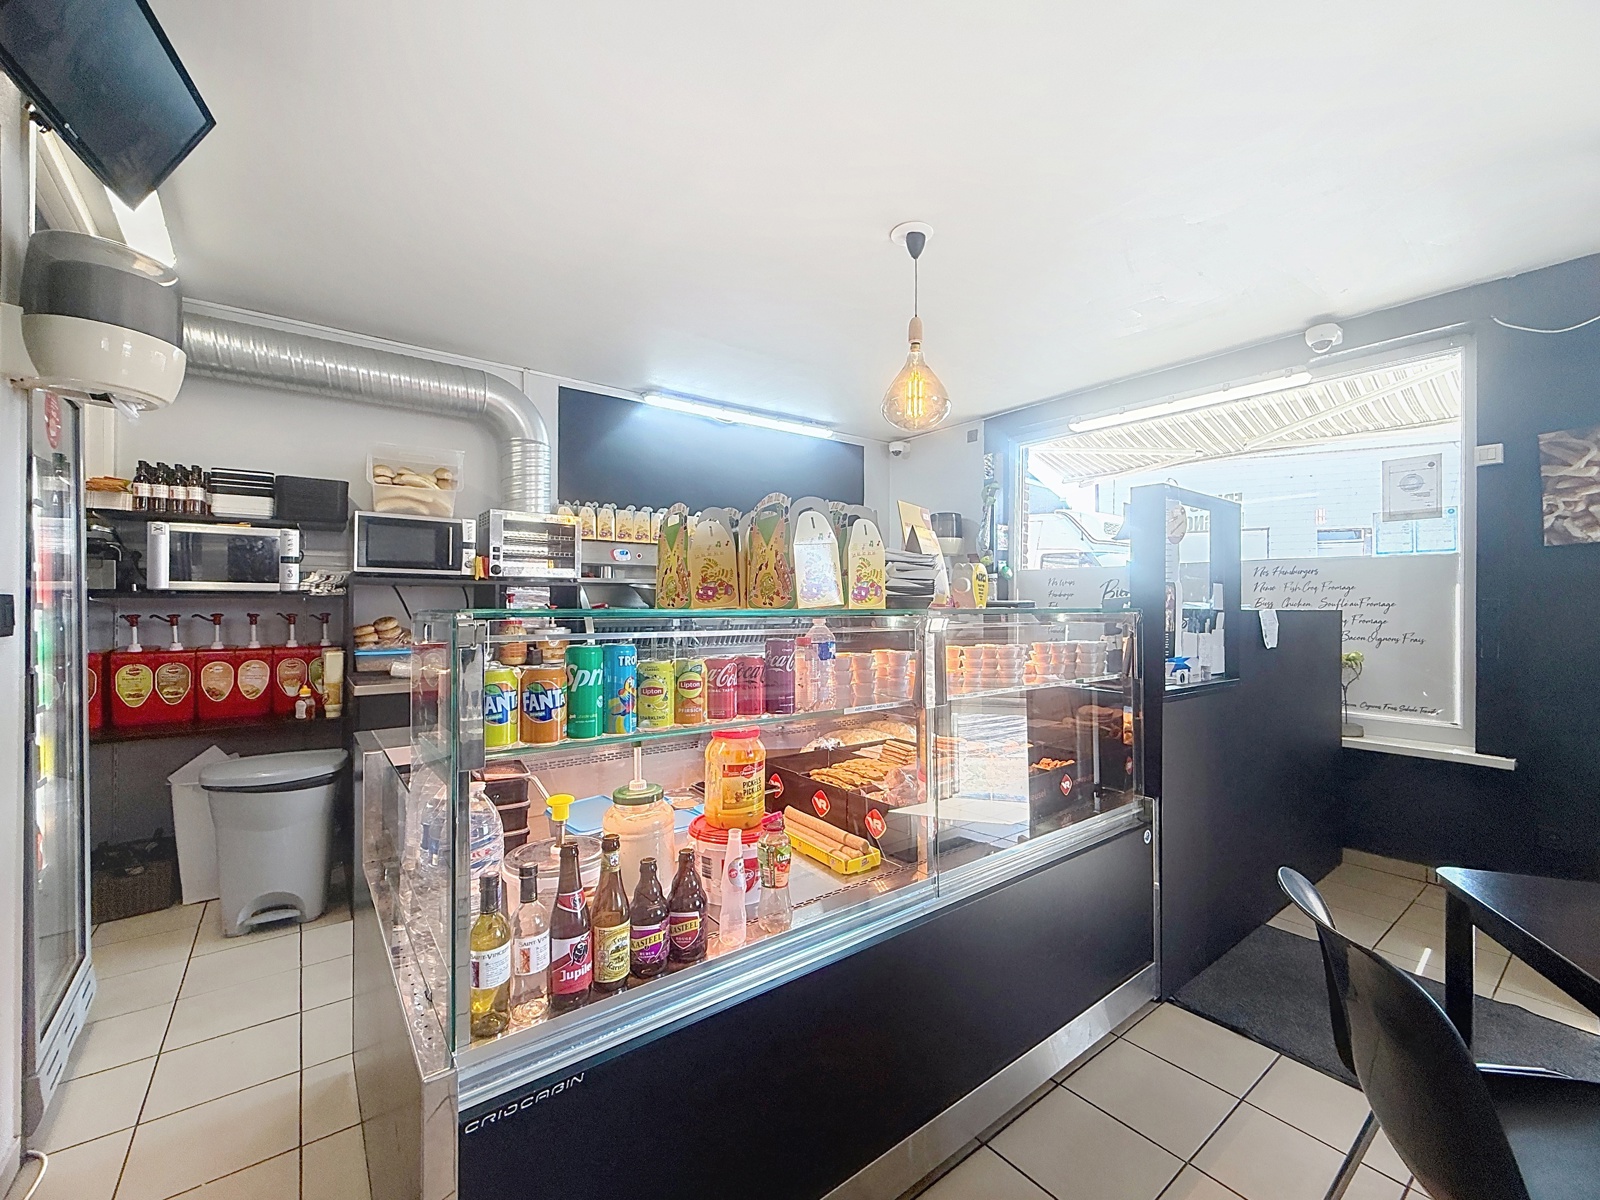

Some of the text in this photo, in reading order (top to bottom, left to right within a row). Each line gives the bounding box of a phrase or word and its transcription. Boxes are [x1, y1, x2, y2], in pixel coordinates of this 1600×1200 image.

[1253, 565, 1319, 579] Nos Hamburgers
[1321, 580, 1356, 598] Fromage
[1358, 596, 1397, 615] Fromage
[1351, 613, 1389, 631] Fromage
[1342, 629, 1366, 643] Bacon
[1402, 631, 1426, 645] Frais
[642, 687, 662, 696] Lipton
[681, 681, 701, 689] Lipton
[465, 1072, 585, 1134] CRIOCABIN
